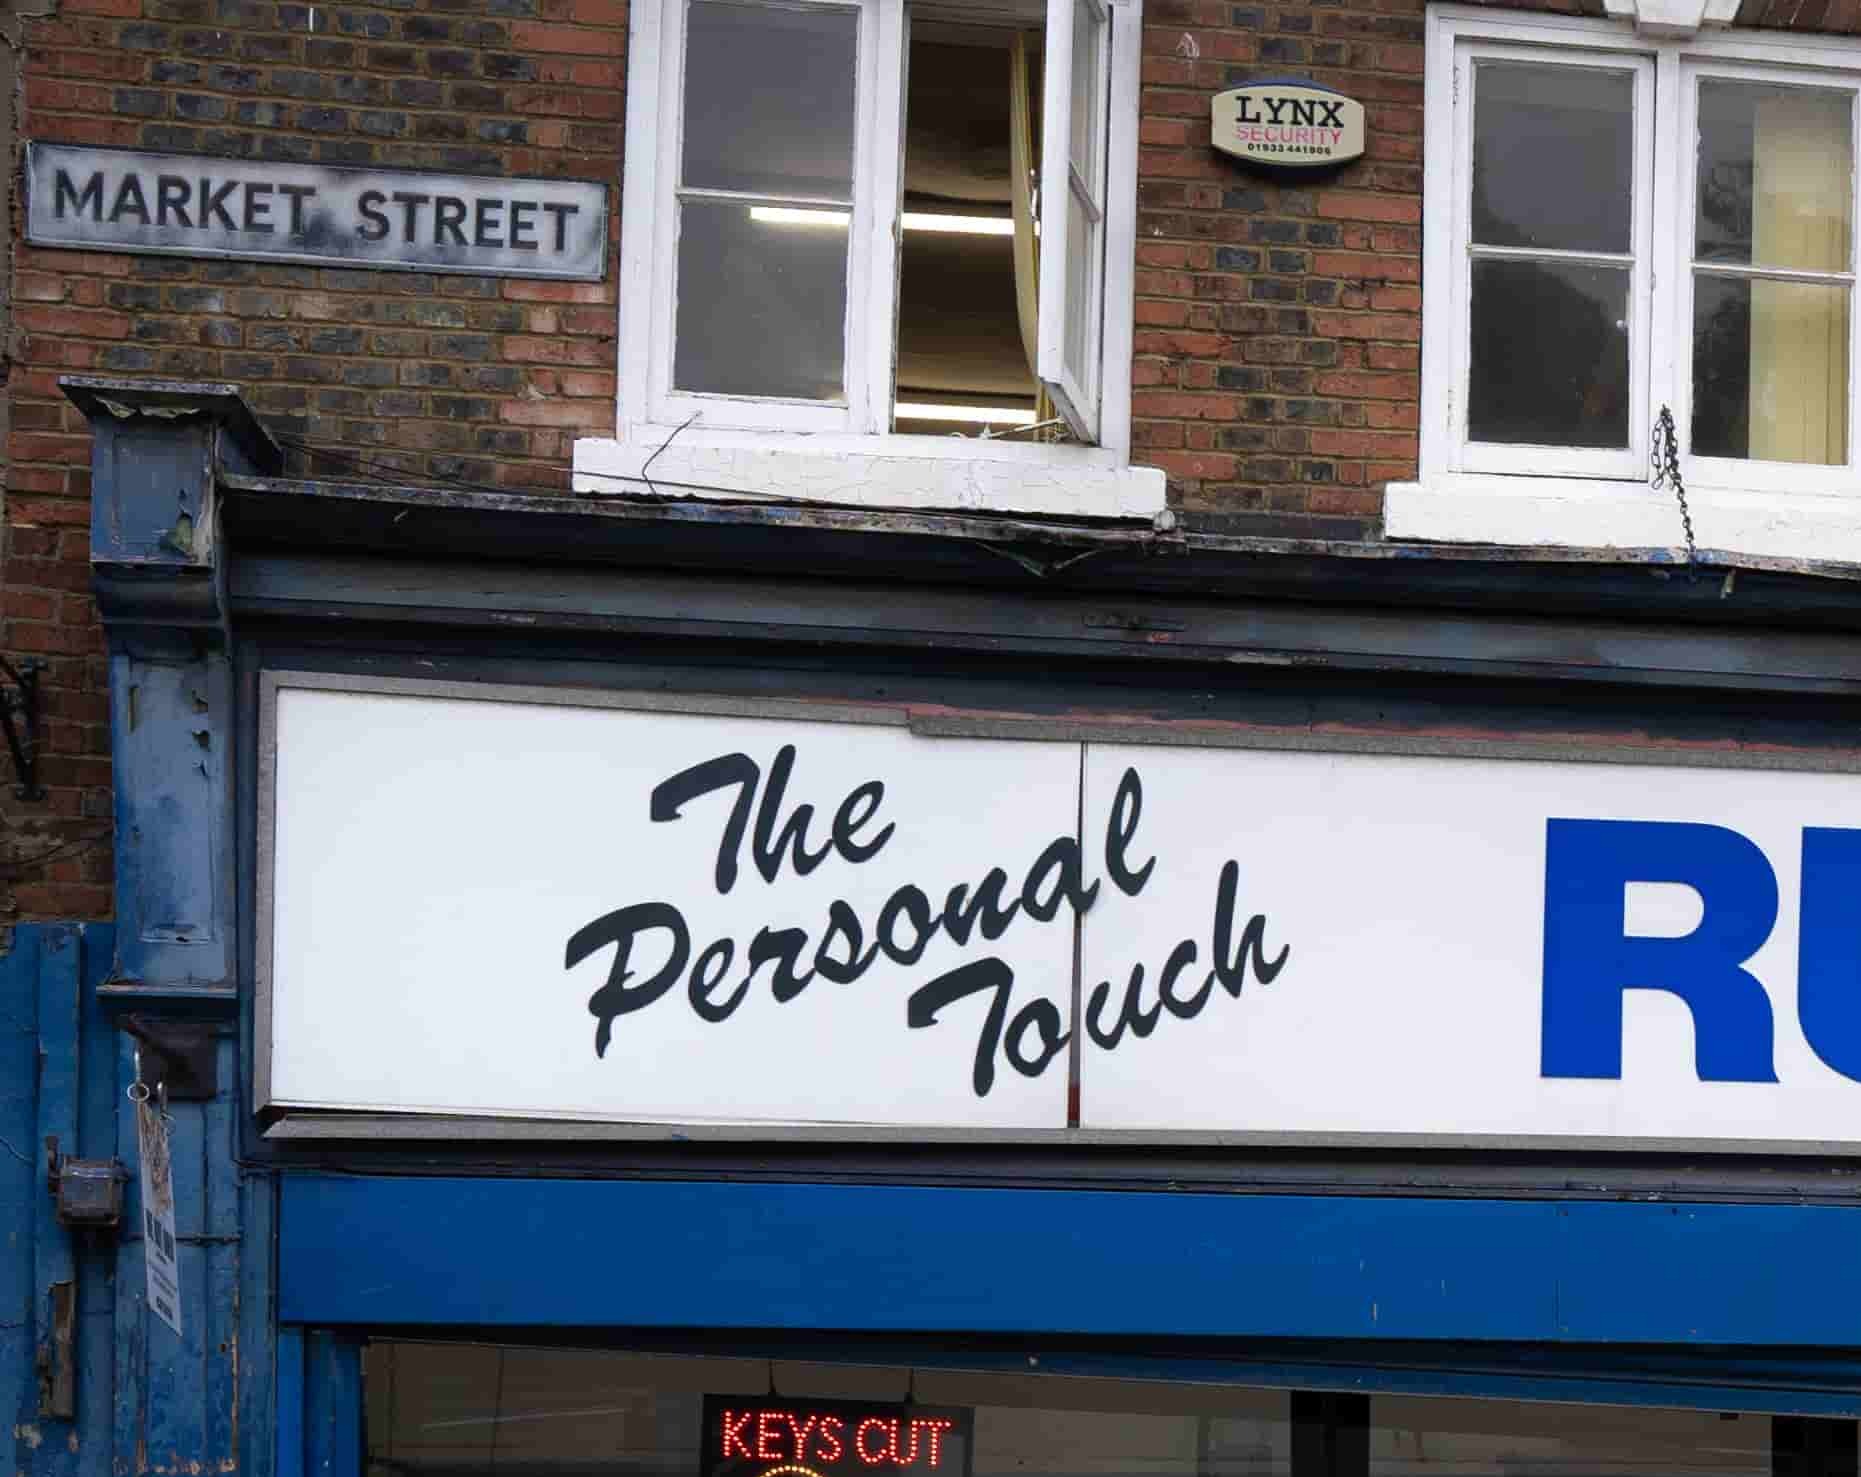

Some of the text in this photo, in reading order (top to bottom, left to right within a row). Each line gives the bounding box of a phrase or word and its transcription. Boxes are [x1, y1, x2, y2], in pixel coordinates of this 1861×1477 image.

[1235, 96, 1345, 128] LYNX
[1237, 125, 1343, 145] SECURITY
[53, 167, 580, 252] MARKET STREET
[650, 744, 895, 895] The
[565, 767, 1156, 1059] Personal
[907, 859, 1290, 1097] Touch
[720, 1410, 952, 1466] KEYS CUT
